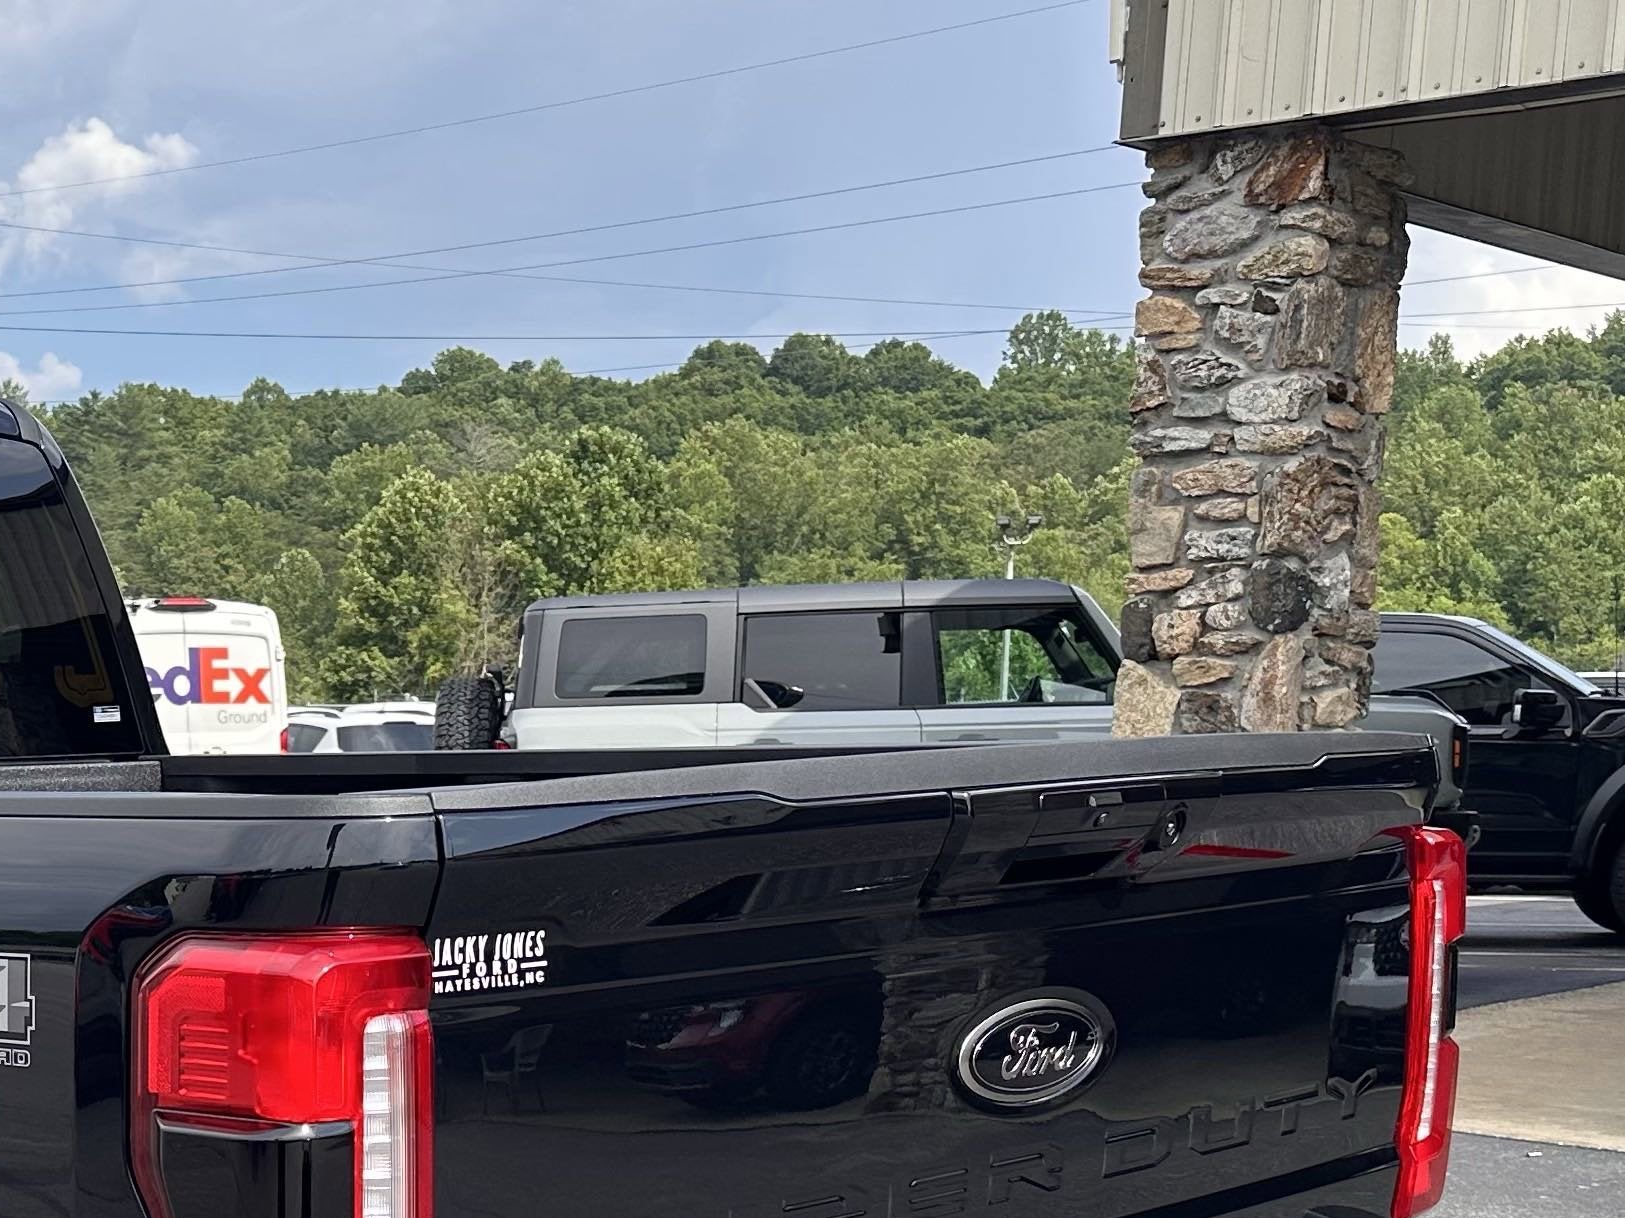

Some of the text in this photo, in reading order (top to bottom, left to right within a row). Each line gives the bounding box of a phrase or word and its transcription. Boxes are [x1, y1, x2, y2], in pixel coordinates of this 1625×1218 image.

[144, 647, 271, 706] edEx
[217, 709, 267, 724] Ground
[433, 929, 546, 967] JACKY JONES
[462, 958, 518, 979] FORD
[1001, 1021, 1077, 1081] Ford
[1102, 1067, 1376, 1178] DUTY
